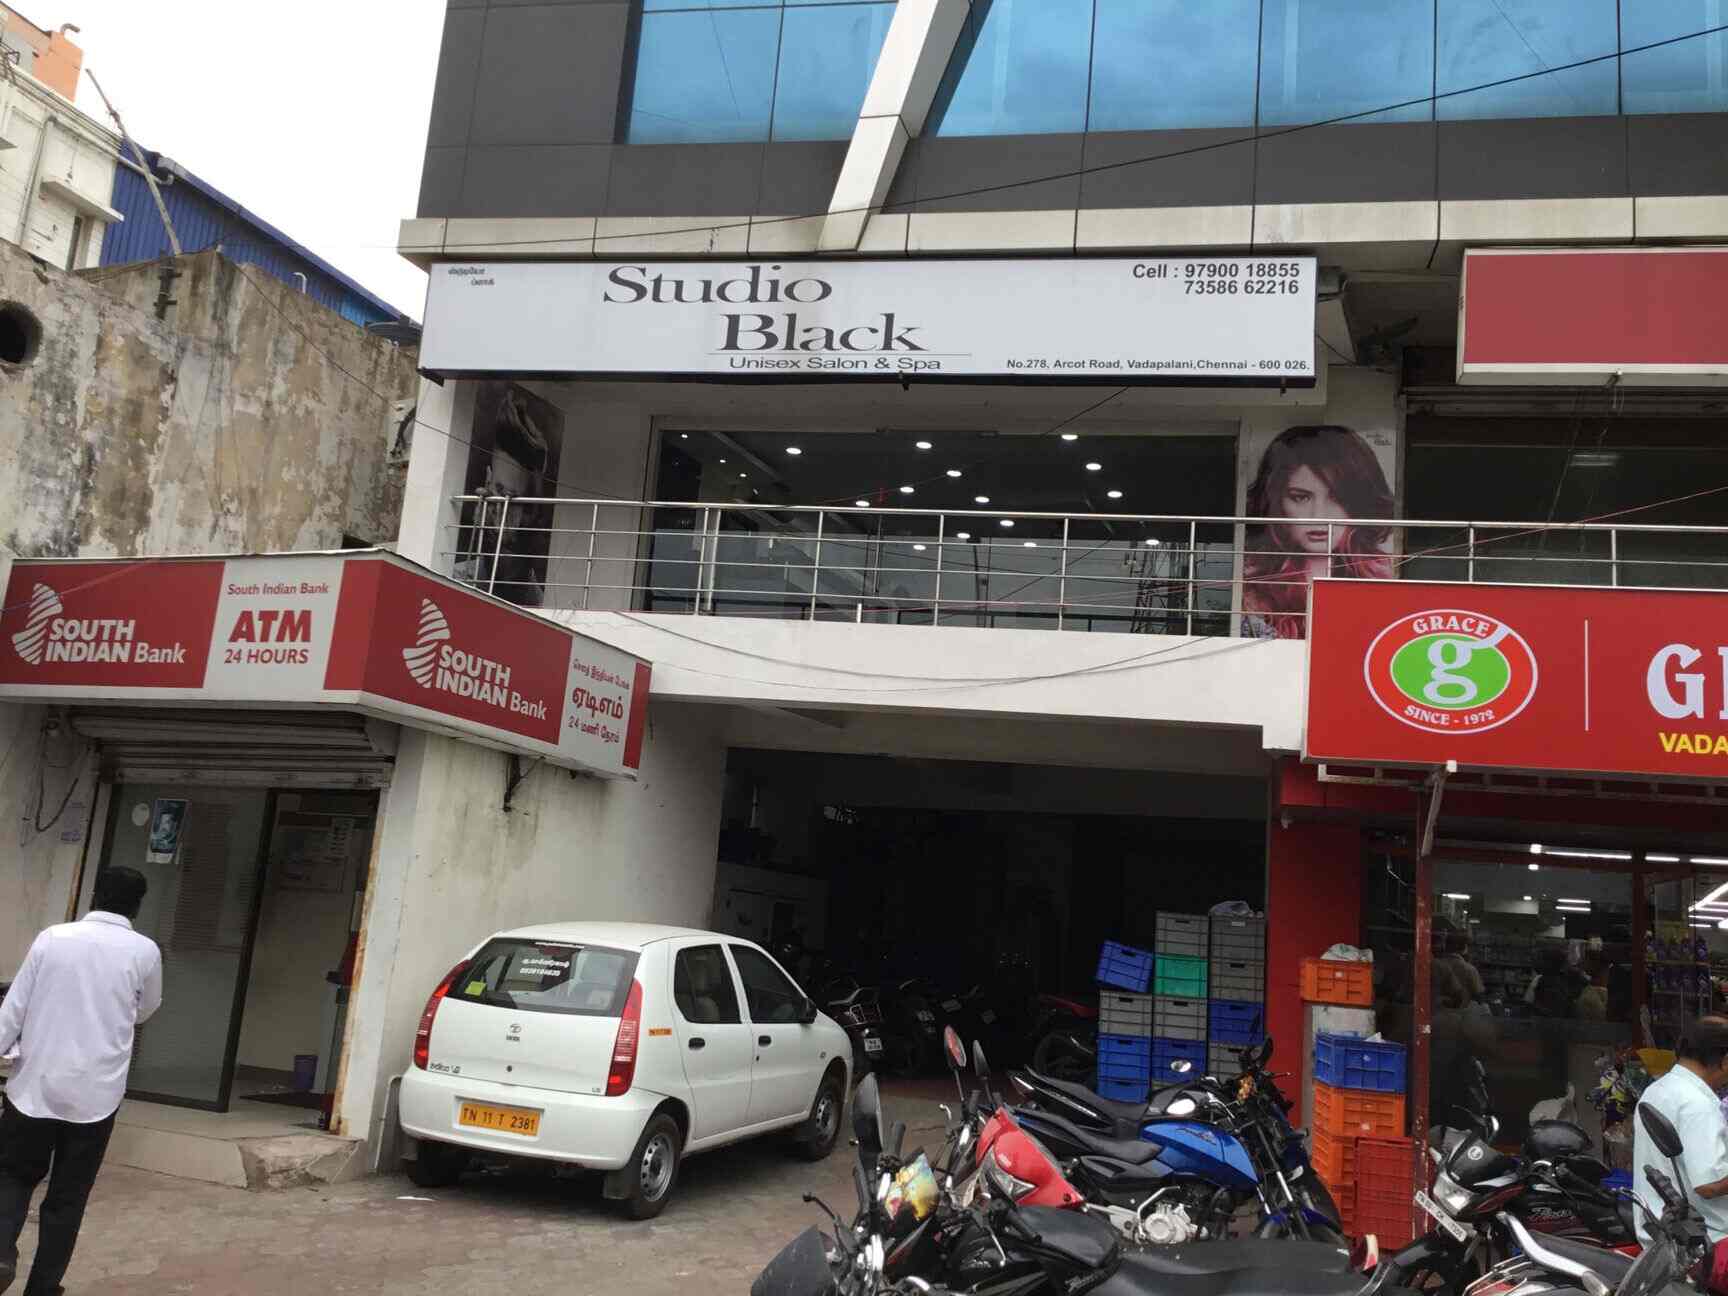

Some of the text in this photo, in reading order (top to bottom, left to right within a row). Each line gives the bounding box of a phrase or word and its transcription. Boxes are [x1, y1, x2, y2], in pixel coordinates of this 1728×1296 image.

[1133, 264, 1167, 278] Cell
[1185, 263, 1239, 277] 97900
[1246, 263, 1300, 277] 18855
[604, 265, 832, 304] Studio
[1184, 280, 1299, 294] 73586 62216
[719, 312, 928, 352] Black
[729, 357, 941, 371] Unisex Salon & Spa
[1054, 360, 1085, 369] Arcot
[1089, 360, 1123, 370] Road,
[1259, 360, 1281, 370] 600
[227, 583, 329, 596] South Indian Bank
[50, 619, 136, 641] SOUTH
[228, 610, 313, 643] ATM
[1412, 615, 1491, 637] GRACE
[45, 643, 185, 664] INDIAN Bank
[224, 648, 309, 664] 24 HOURS
[439, 645, 511, 687] SOUTH
[1646, 643, 1728, 720] G
[435, 668, 547, 720] INDIAN Bank
[1404, 704, 1450, 726] SINCE
[463, 1106, 478, 1121] TN
[483, 1111, 493, 1124] 11
[511, 1116, 536, 1132] 2381
